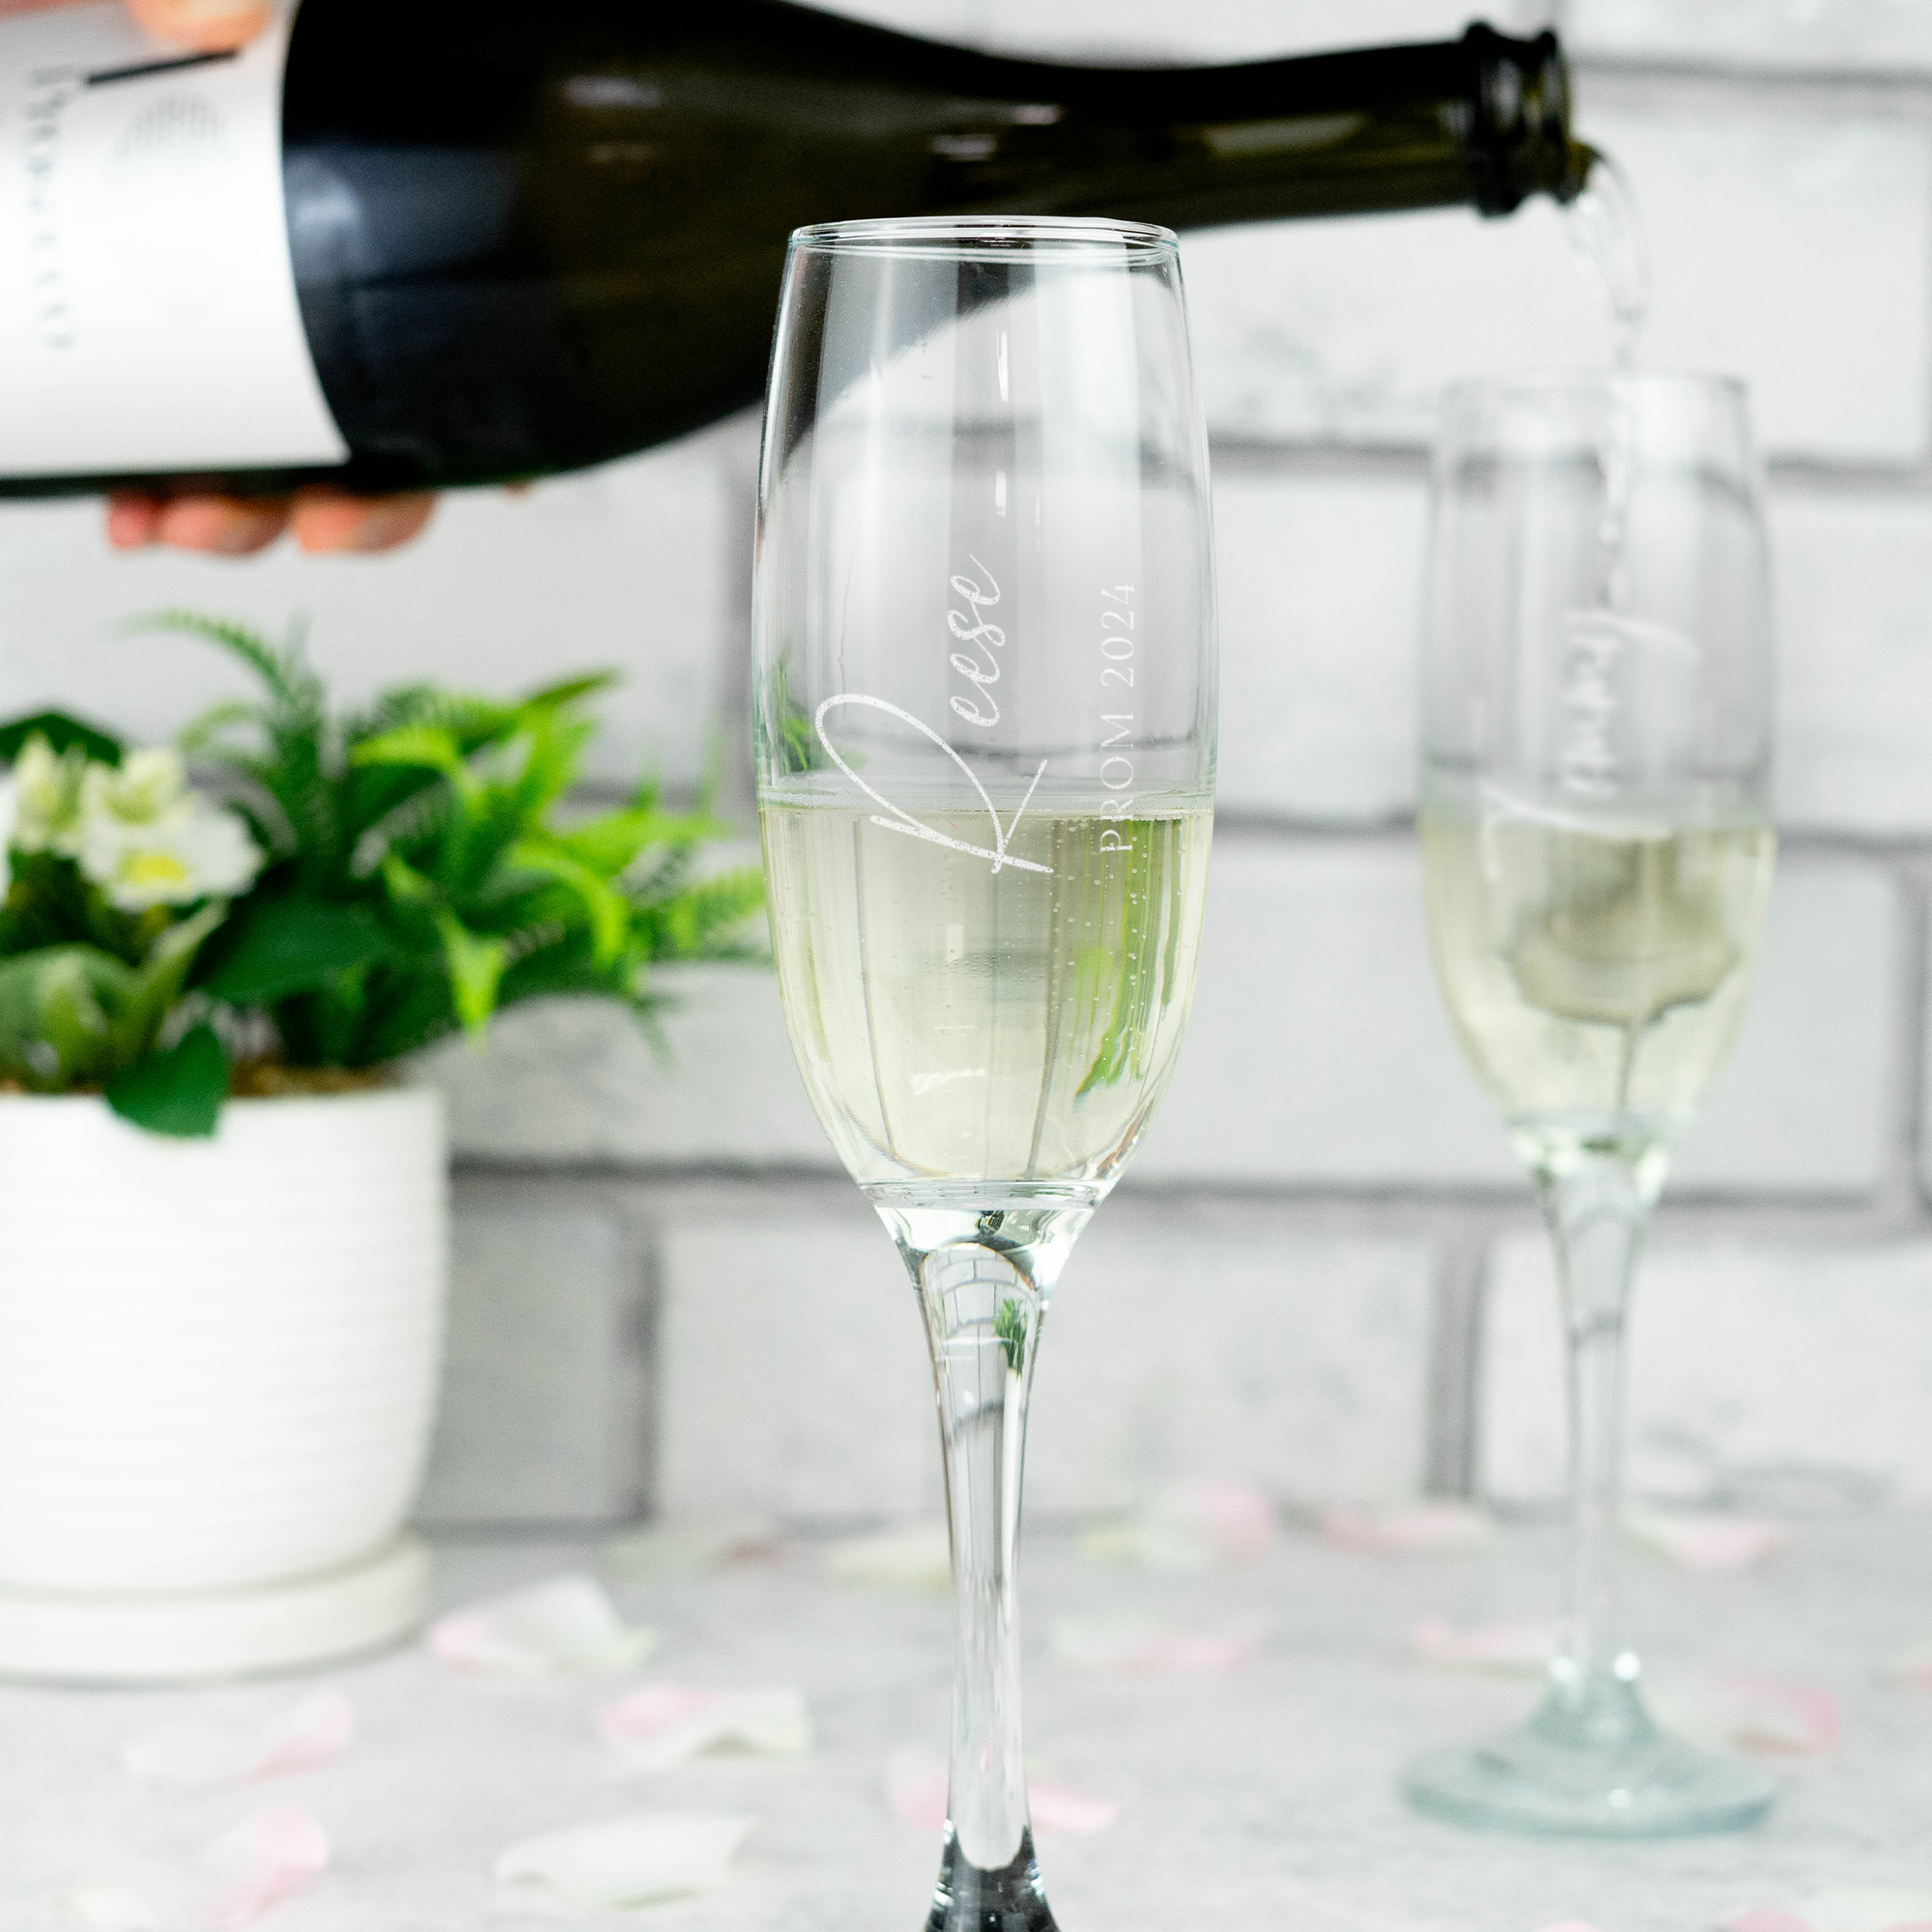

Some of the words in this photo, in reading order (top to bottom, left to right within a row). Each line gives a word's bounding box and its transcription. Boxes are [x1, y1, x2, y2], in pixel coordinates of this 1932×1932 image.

[1100, 582, 1135, 688] 2024
[815, 554, 1054, 874] Reese
[1100, 713, 1134, 852] PROM
